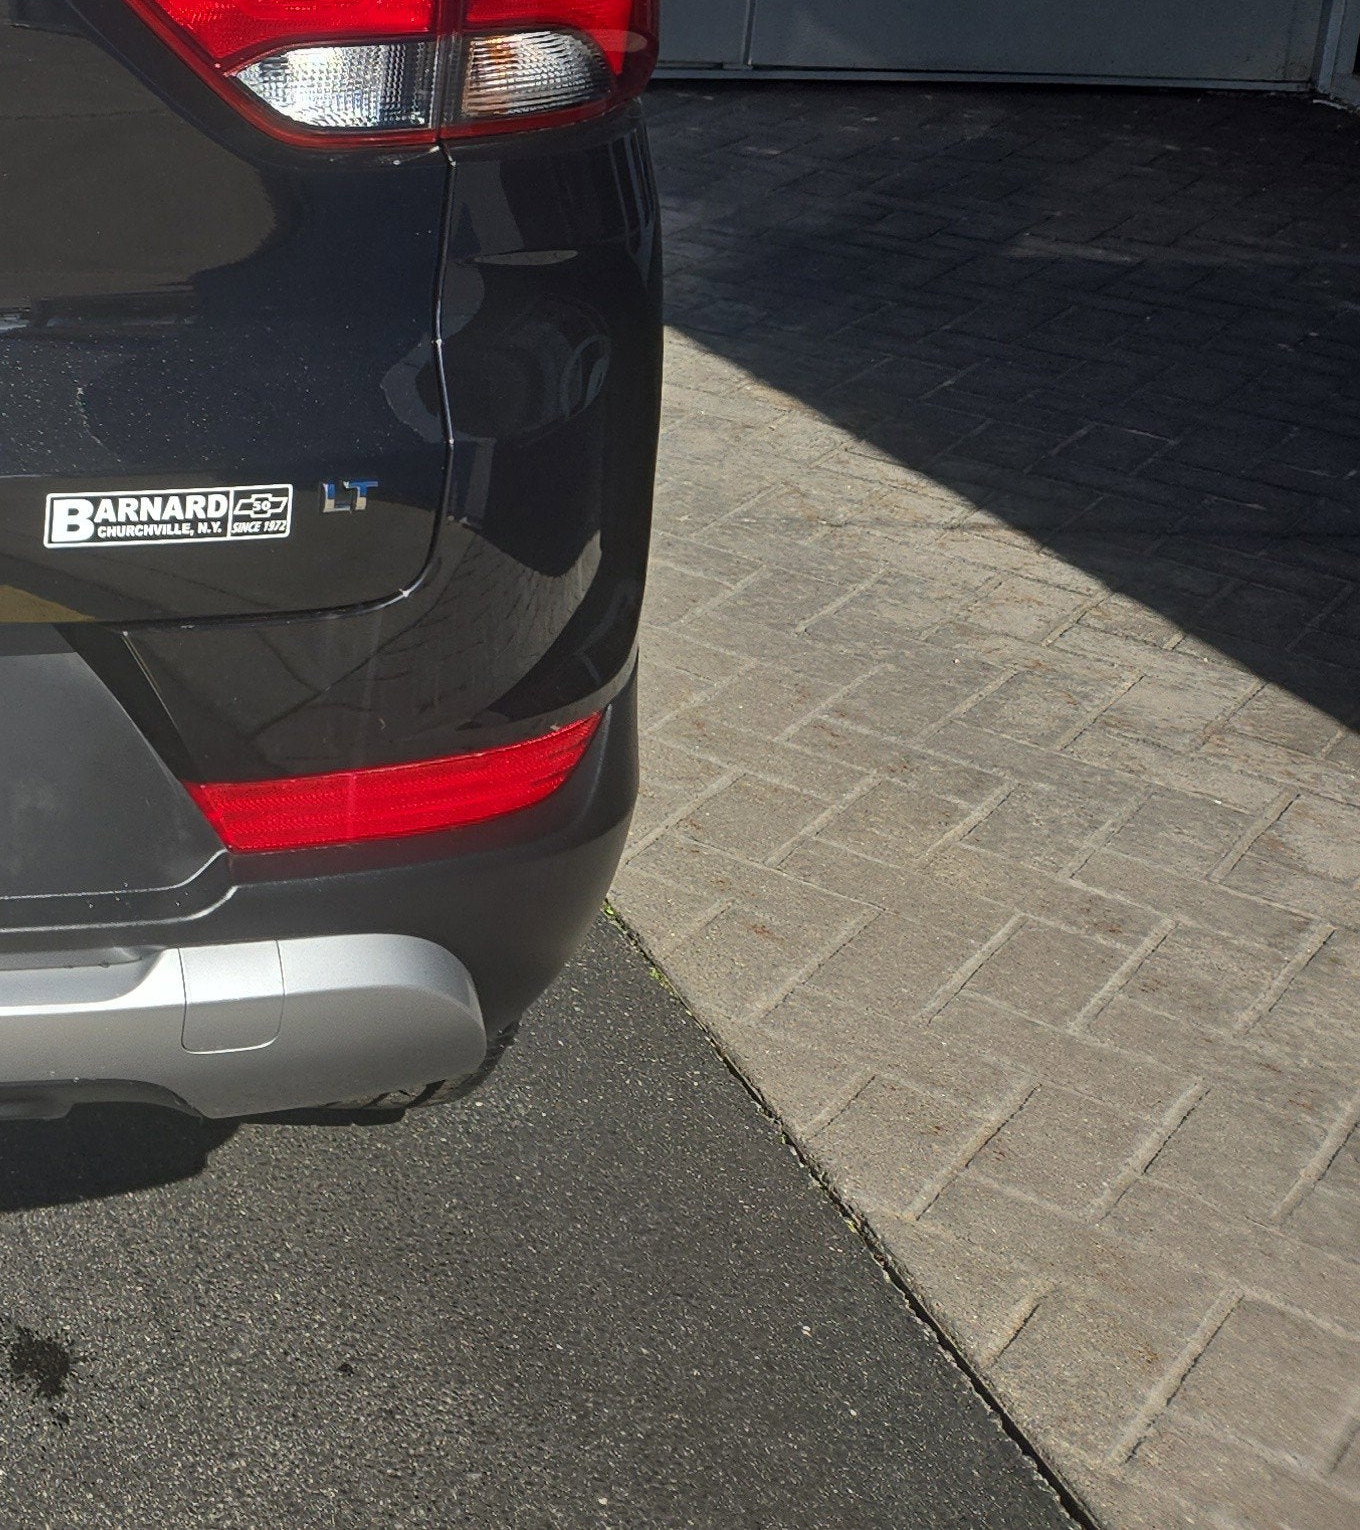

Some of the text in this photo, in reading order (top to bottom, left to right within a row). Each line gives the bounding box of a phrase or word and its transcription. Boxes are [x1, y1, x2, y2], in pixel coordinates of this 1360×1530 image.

[320, 480, 379, 513] LT
[51, 494, 228, 543] BARNARD
[97, 520, 222, 539] CHURCHVILLE, N.Y.
[231, 520, 286, 534] SINCE 1972
